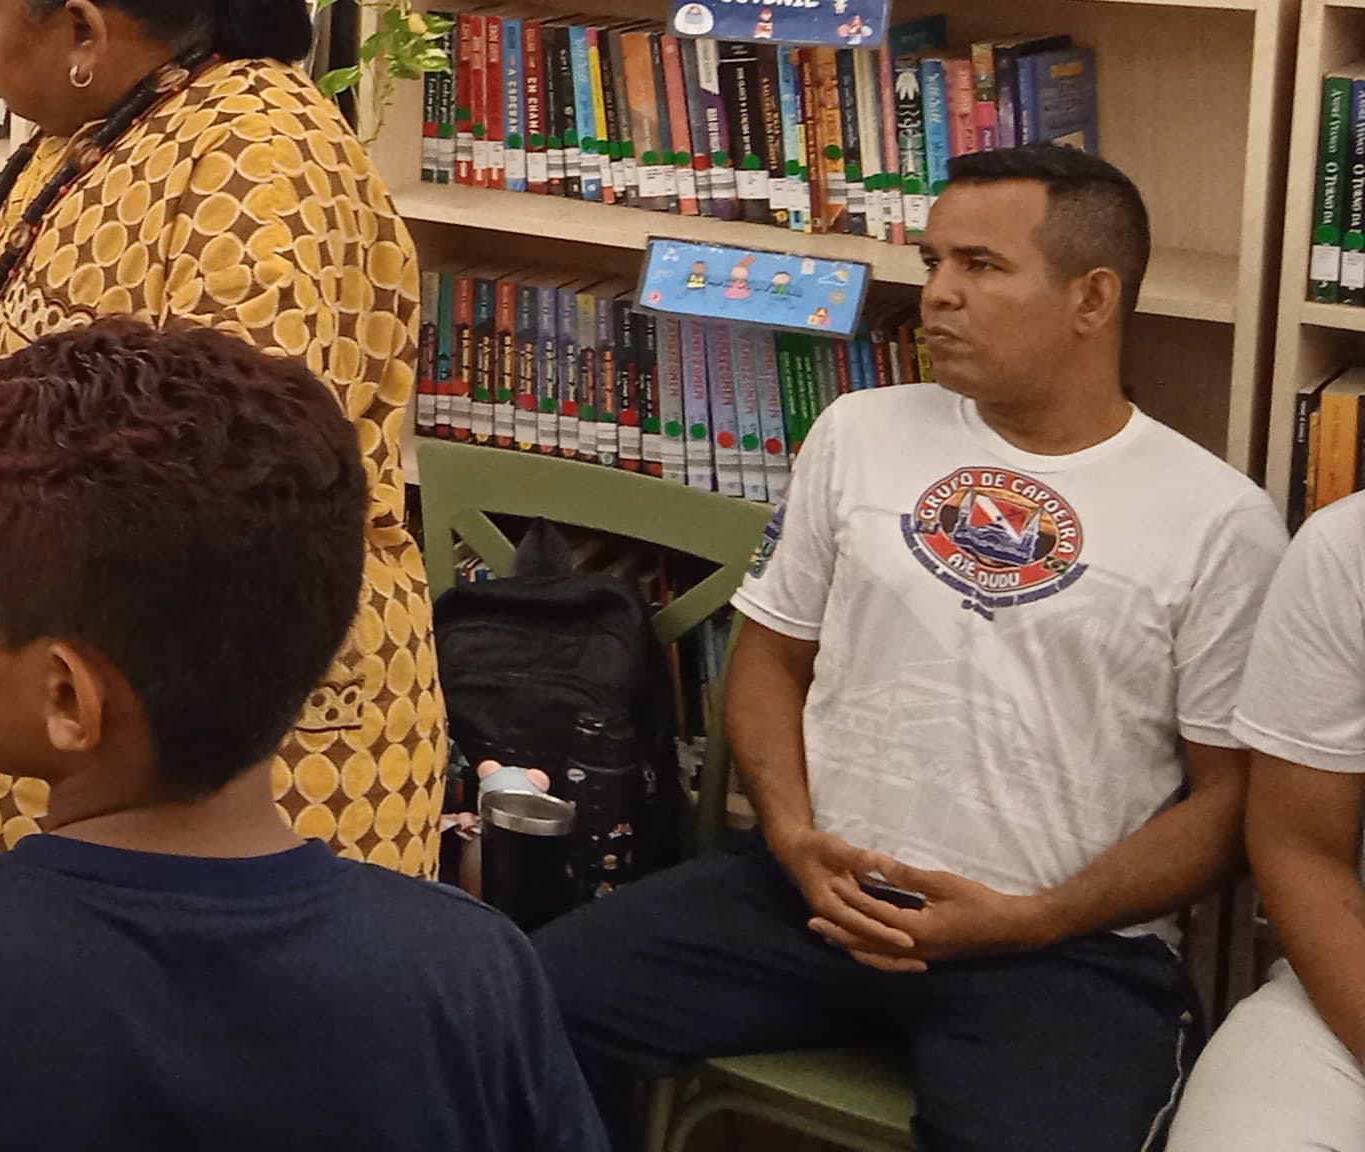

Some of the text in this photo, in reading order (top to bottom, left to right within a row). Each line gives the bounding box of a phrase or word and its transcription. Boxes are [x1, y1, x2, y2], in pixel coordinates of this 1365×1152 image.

[981, 472, 1007, 487] DE
[1010, 478, 1078, 554] CAPOEIRA
[977, 571, 1021, 589] DUDU
